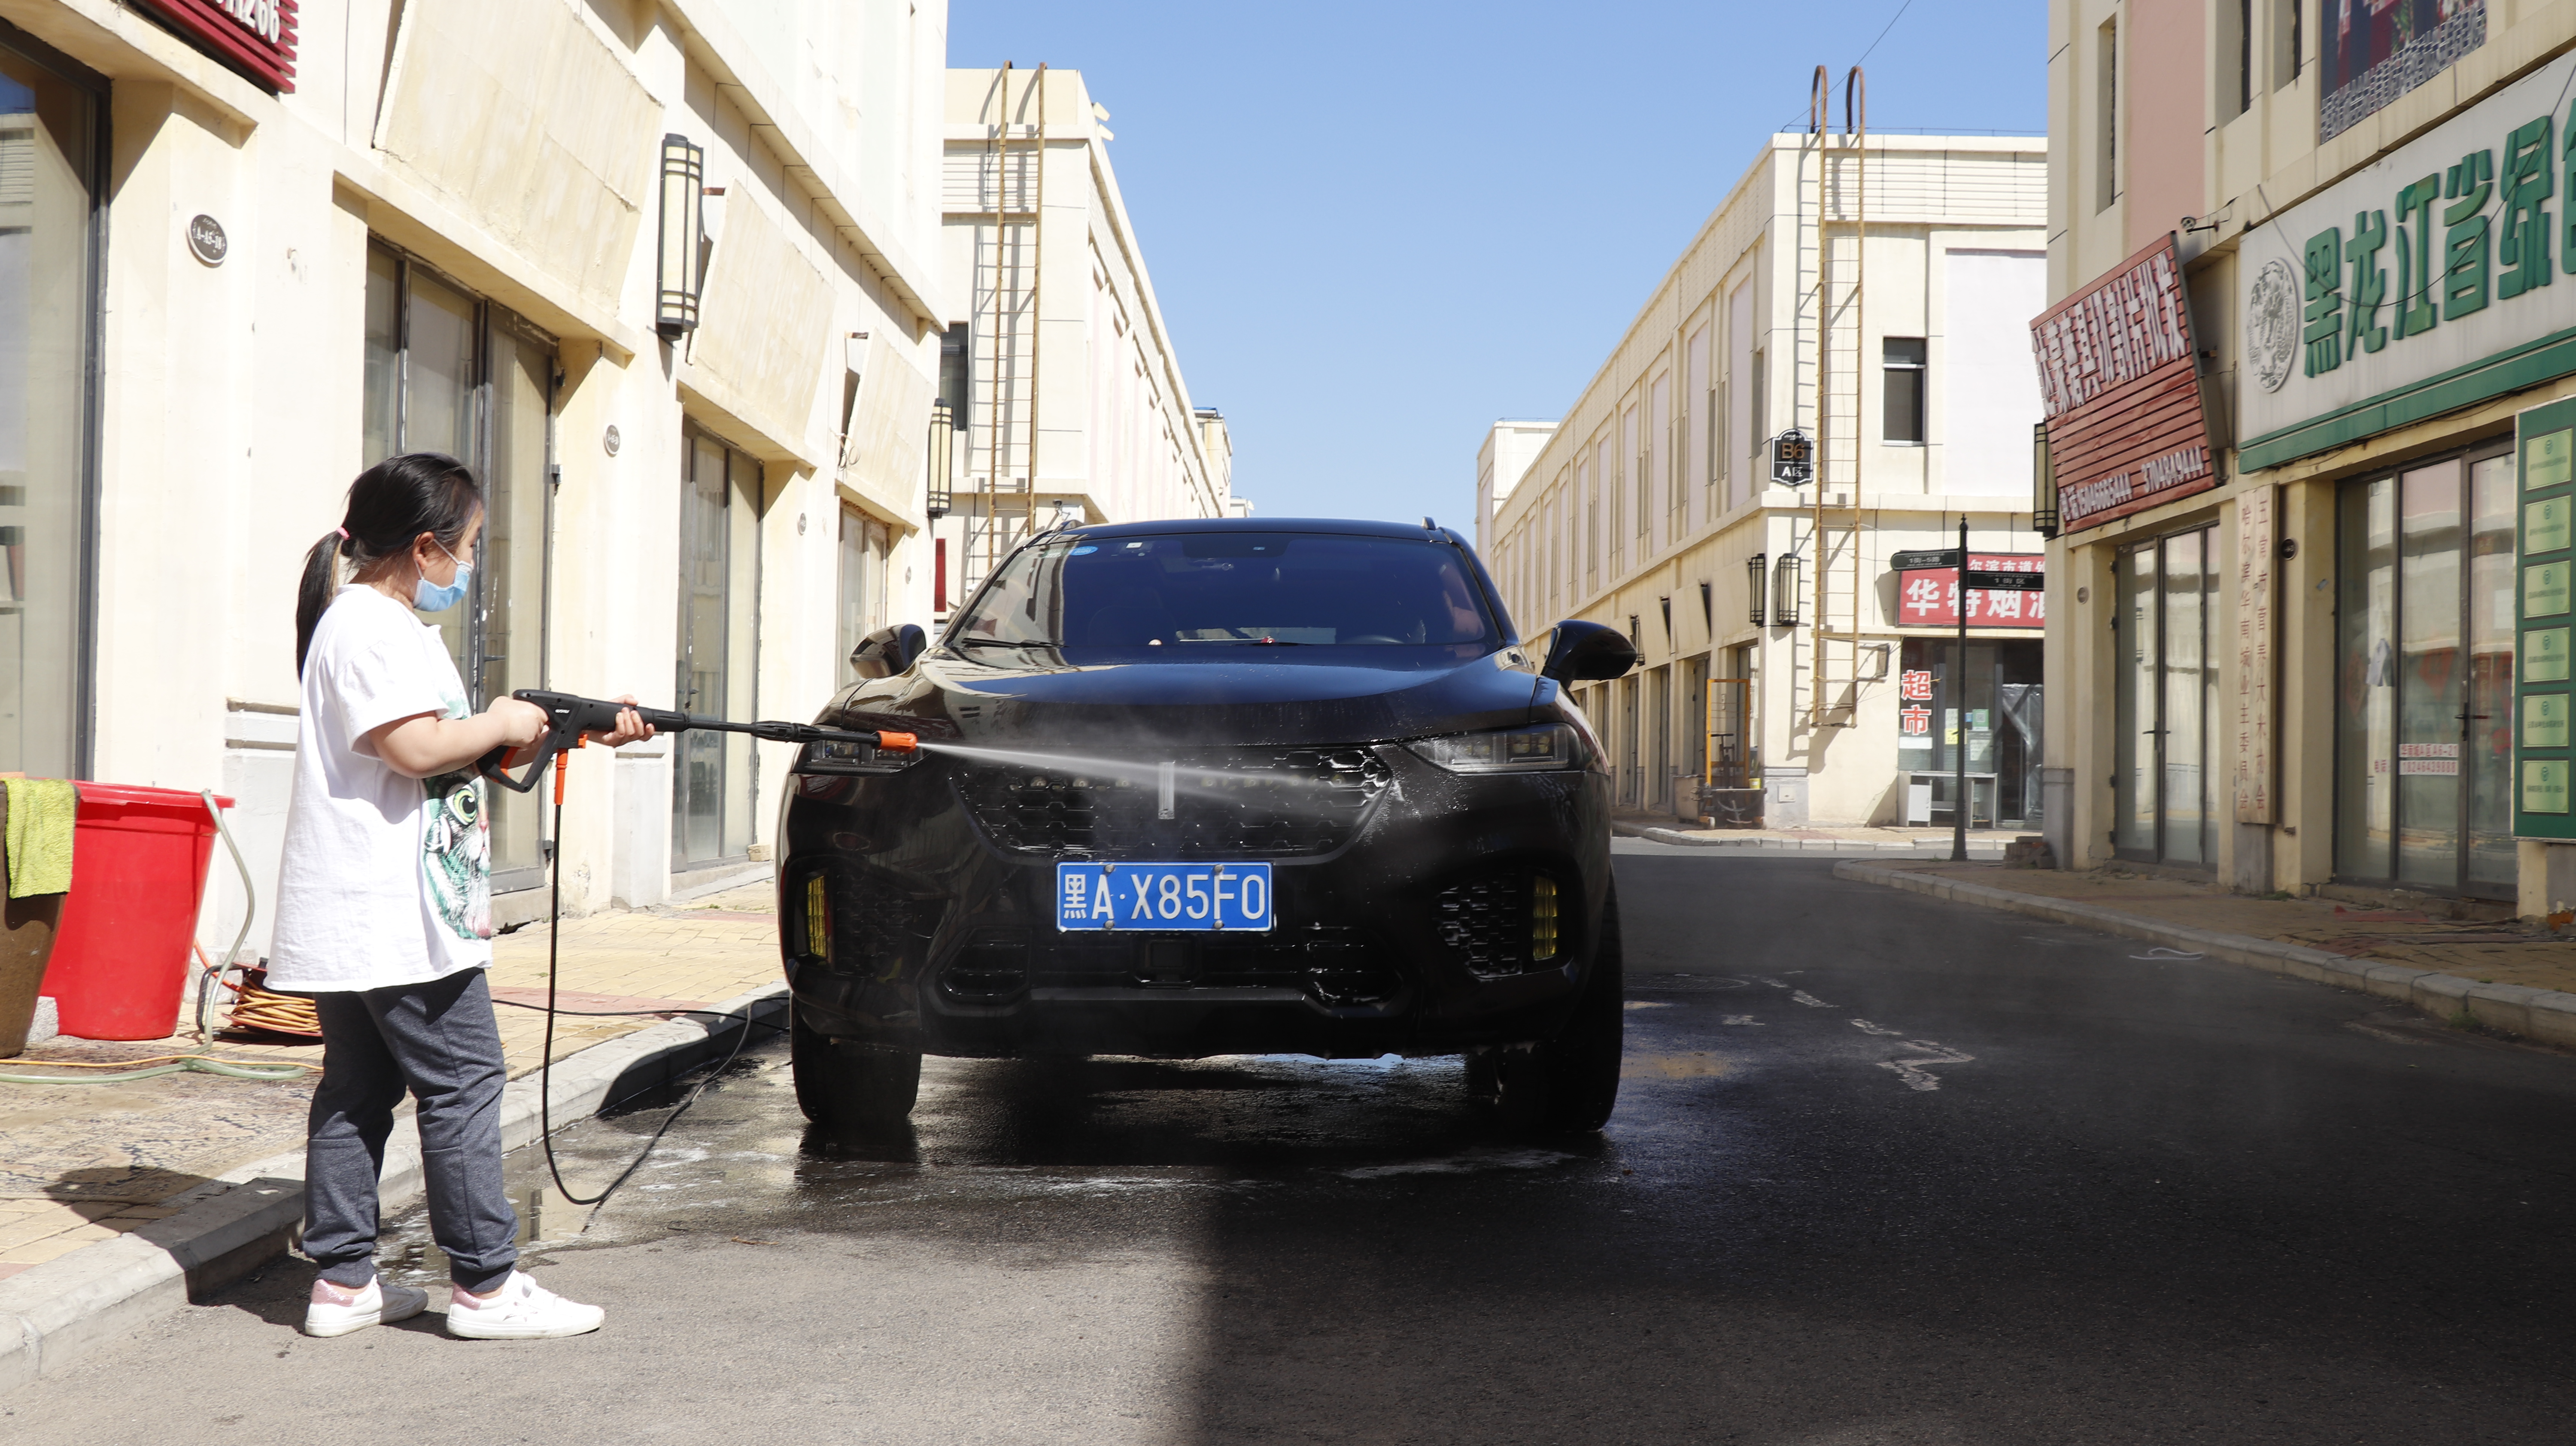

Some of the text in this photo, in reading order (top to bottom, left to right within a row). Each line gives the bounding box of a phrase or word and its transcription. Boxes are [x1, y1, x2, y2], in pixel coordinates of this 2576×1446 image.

[1781, 443, 1805, 459] B6
[1781, 466, 1803, 477] A区
[1901, 669, 1933, 735] 超市
